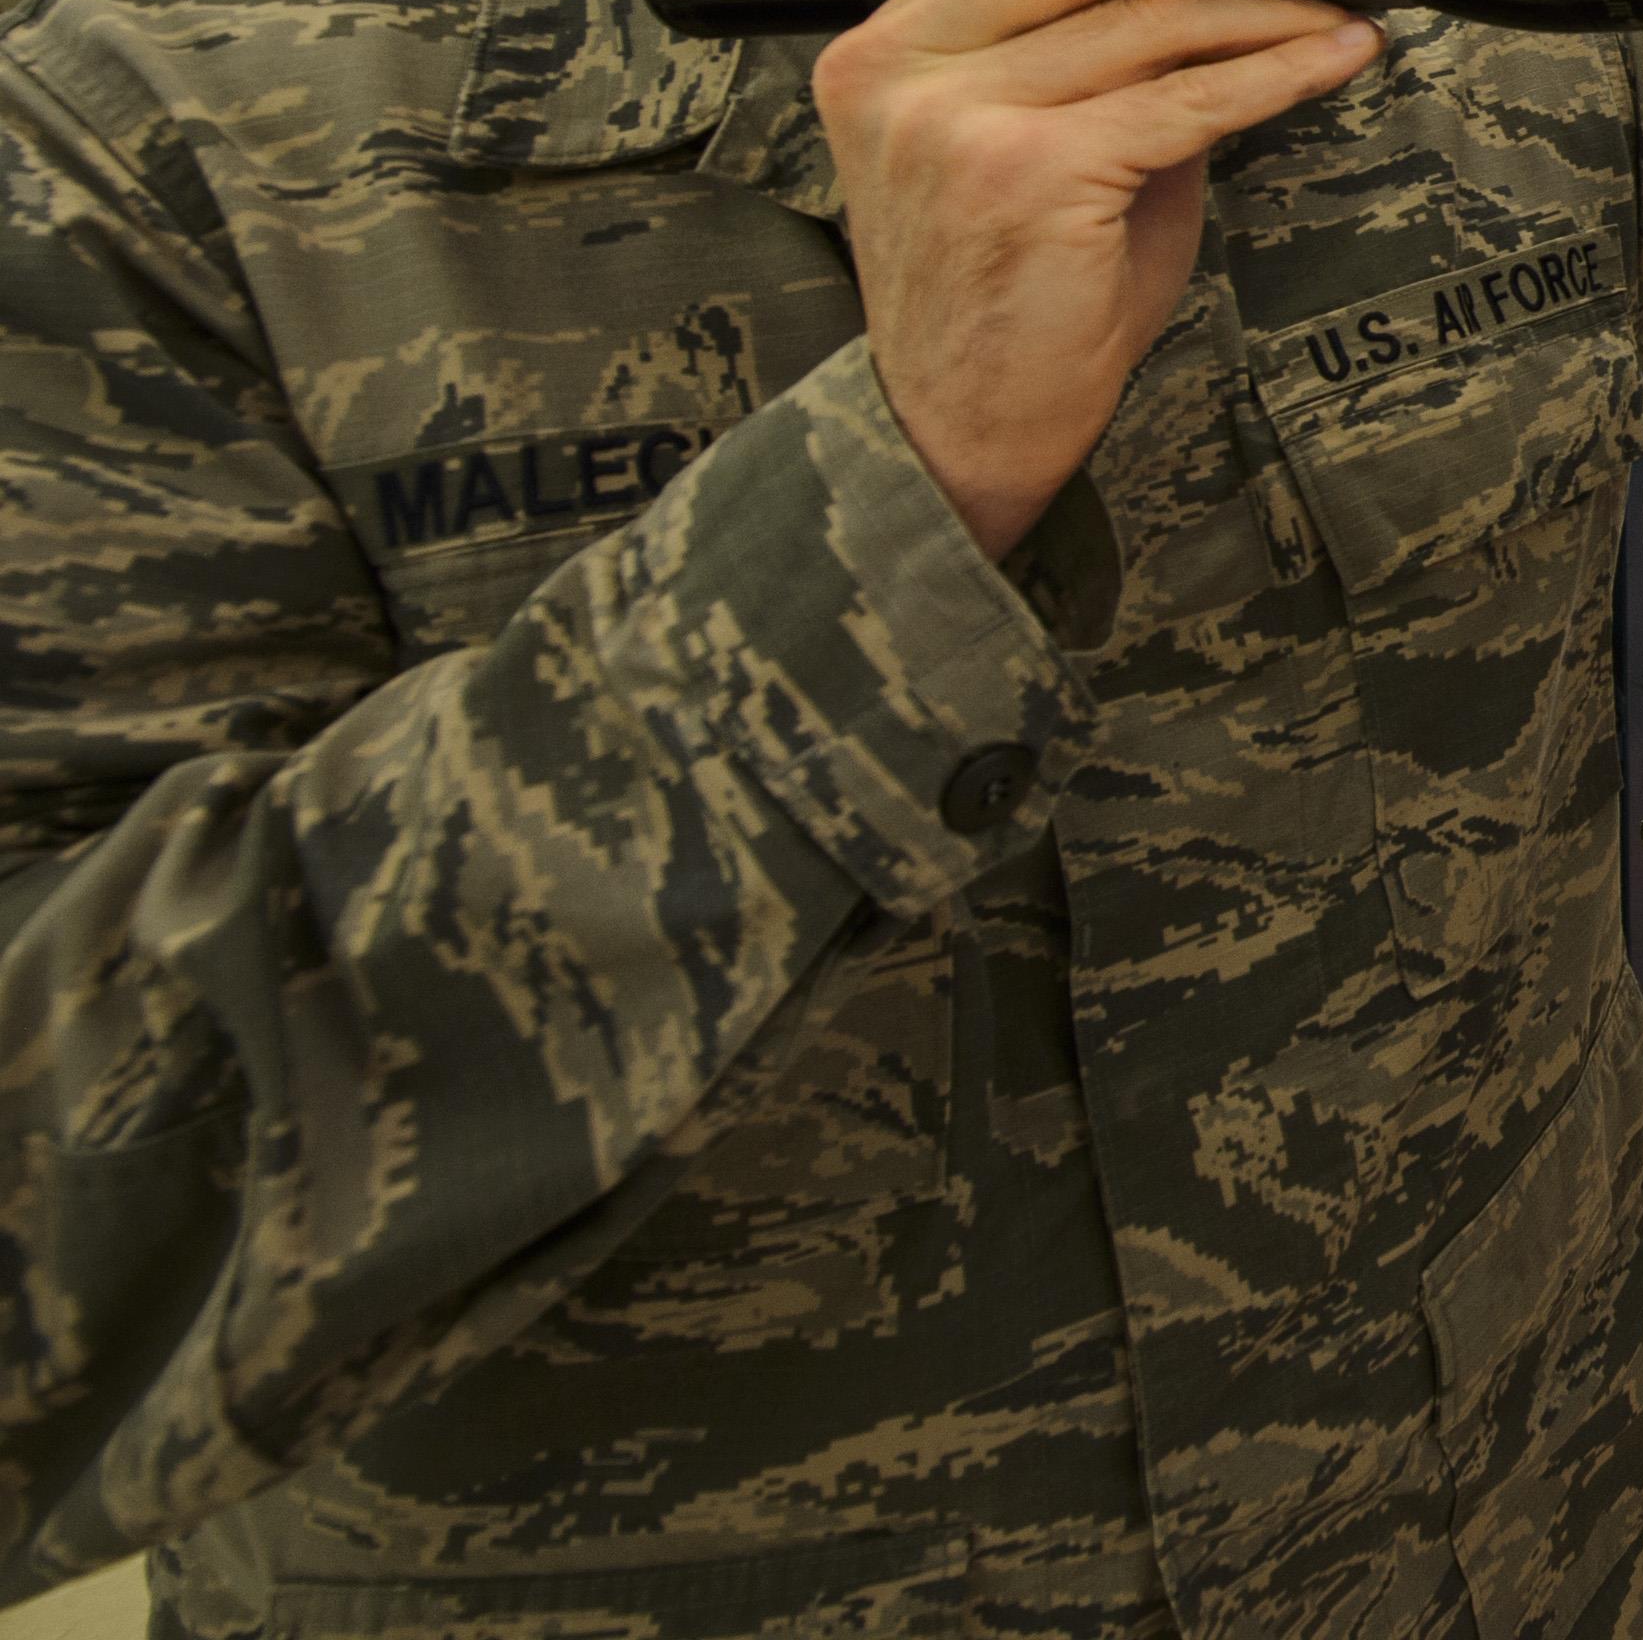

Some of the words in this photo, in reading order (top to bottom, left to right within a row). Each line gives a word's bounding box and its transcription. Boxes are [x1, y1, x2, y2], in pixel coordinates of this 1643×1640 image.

[1305, 311, 1419, 382] U.S.
[1481, 242, 1603, 324] FORCE
[375, 430, 716, 548] MALEC
